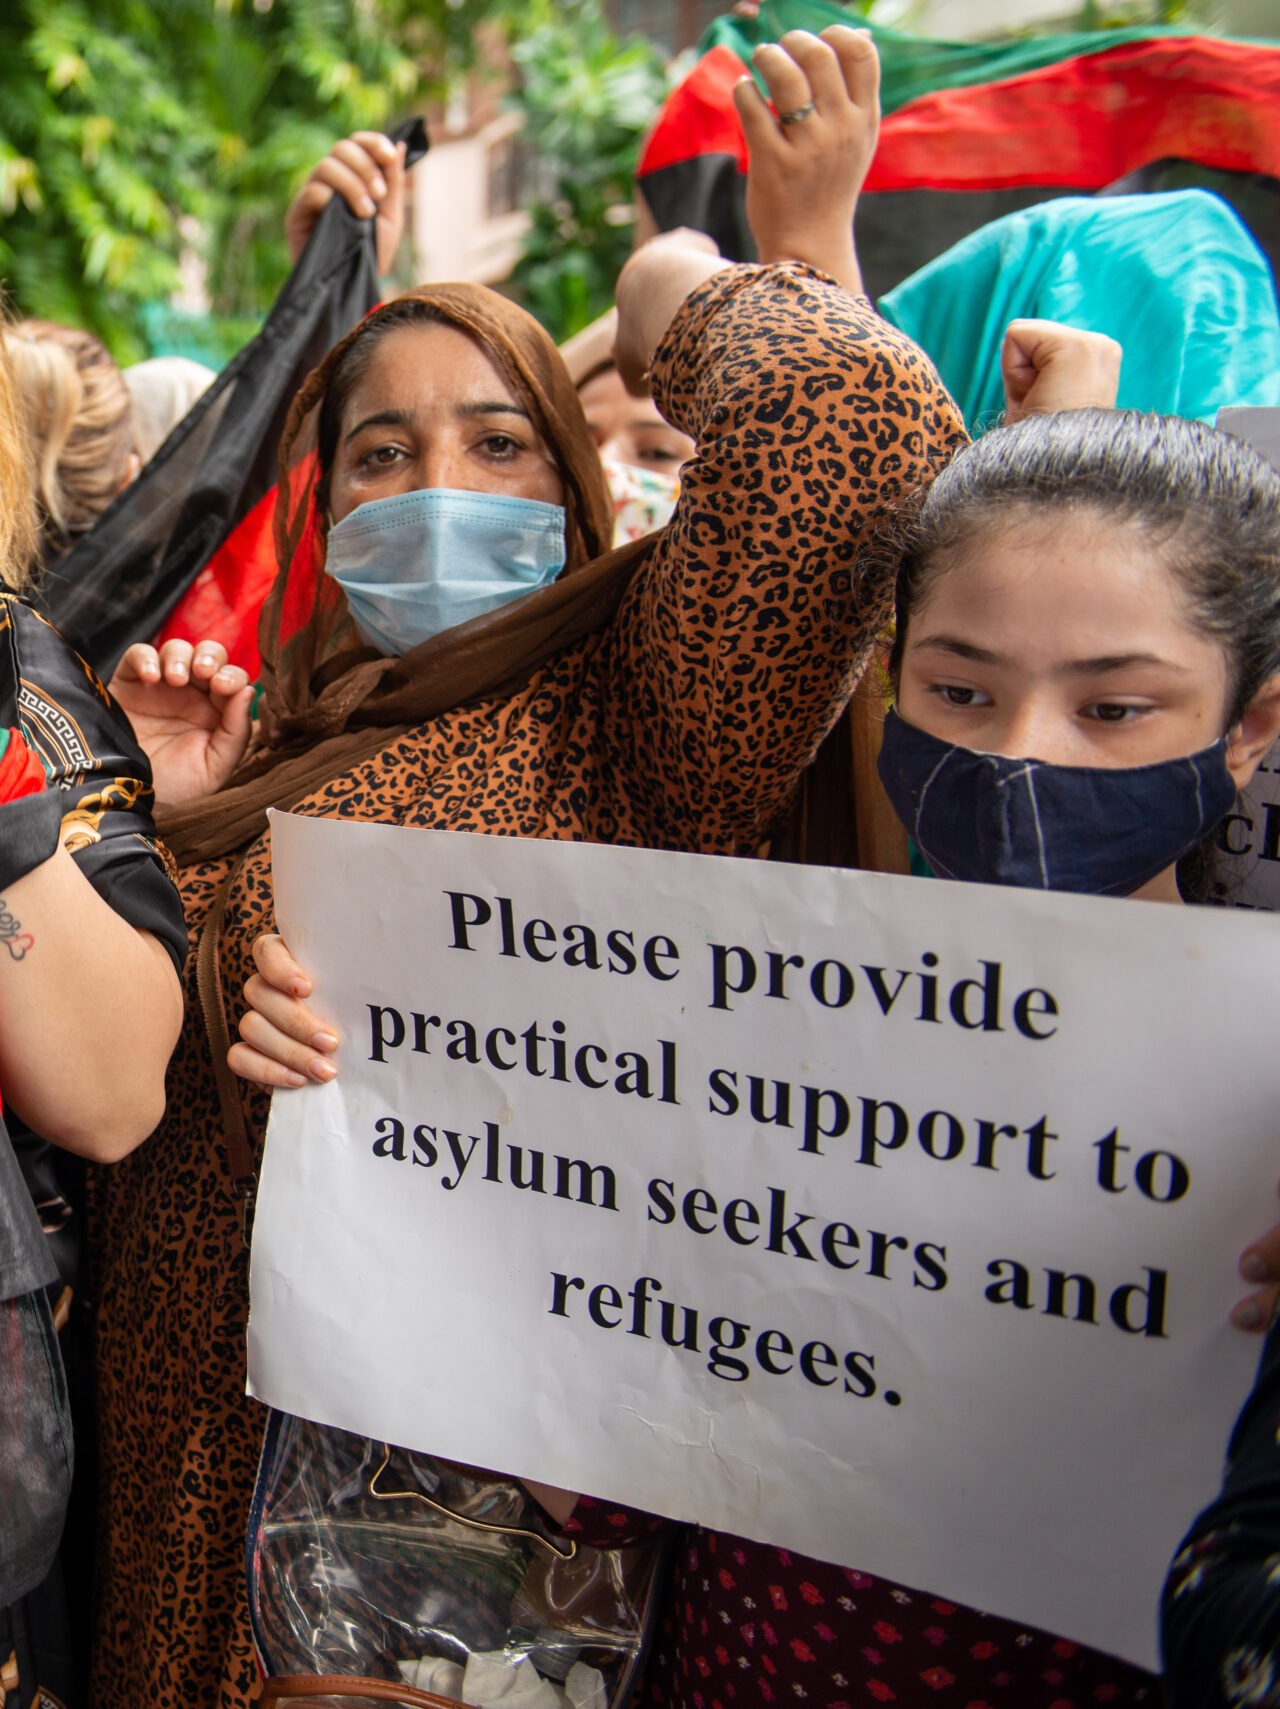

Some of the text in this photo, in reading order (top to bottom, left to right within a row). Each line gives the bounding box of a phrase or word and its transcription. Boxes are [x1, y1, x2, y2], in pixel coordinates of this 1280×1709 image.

[442, 889, 1060, 1042] Please provide
[365, 1002, 1193, 1207] practical support to
[371, 1116, 1171, 1339] asylum seekers and
[547, 1270, 904, 1409] refugees.
